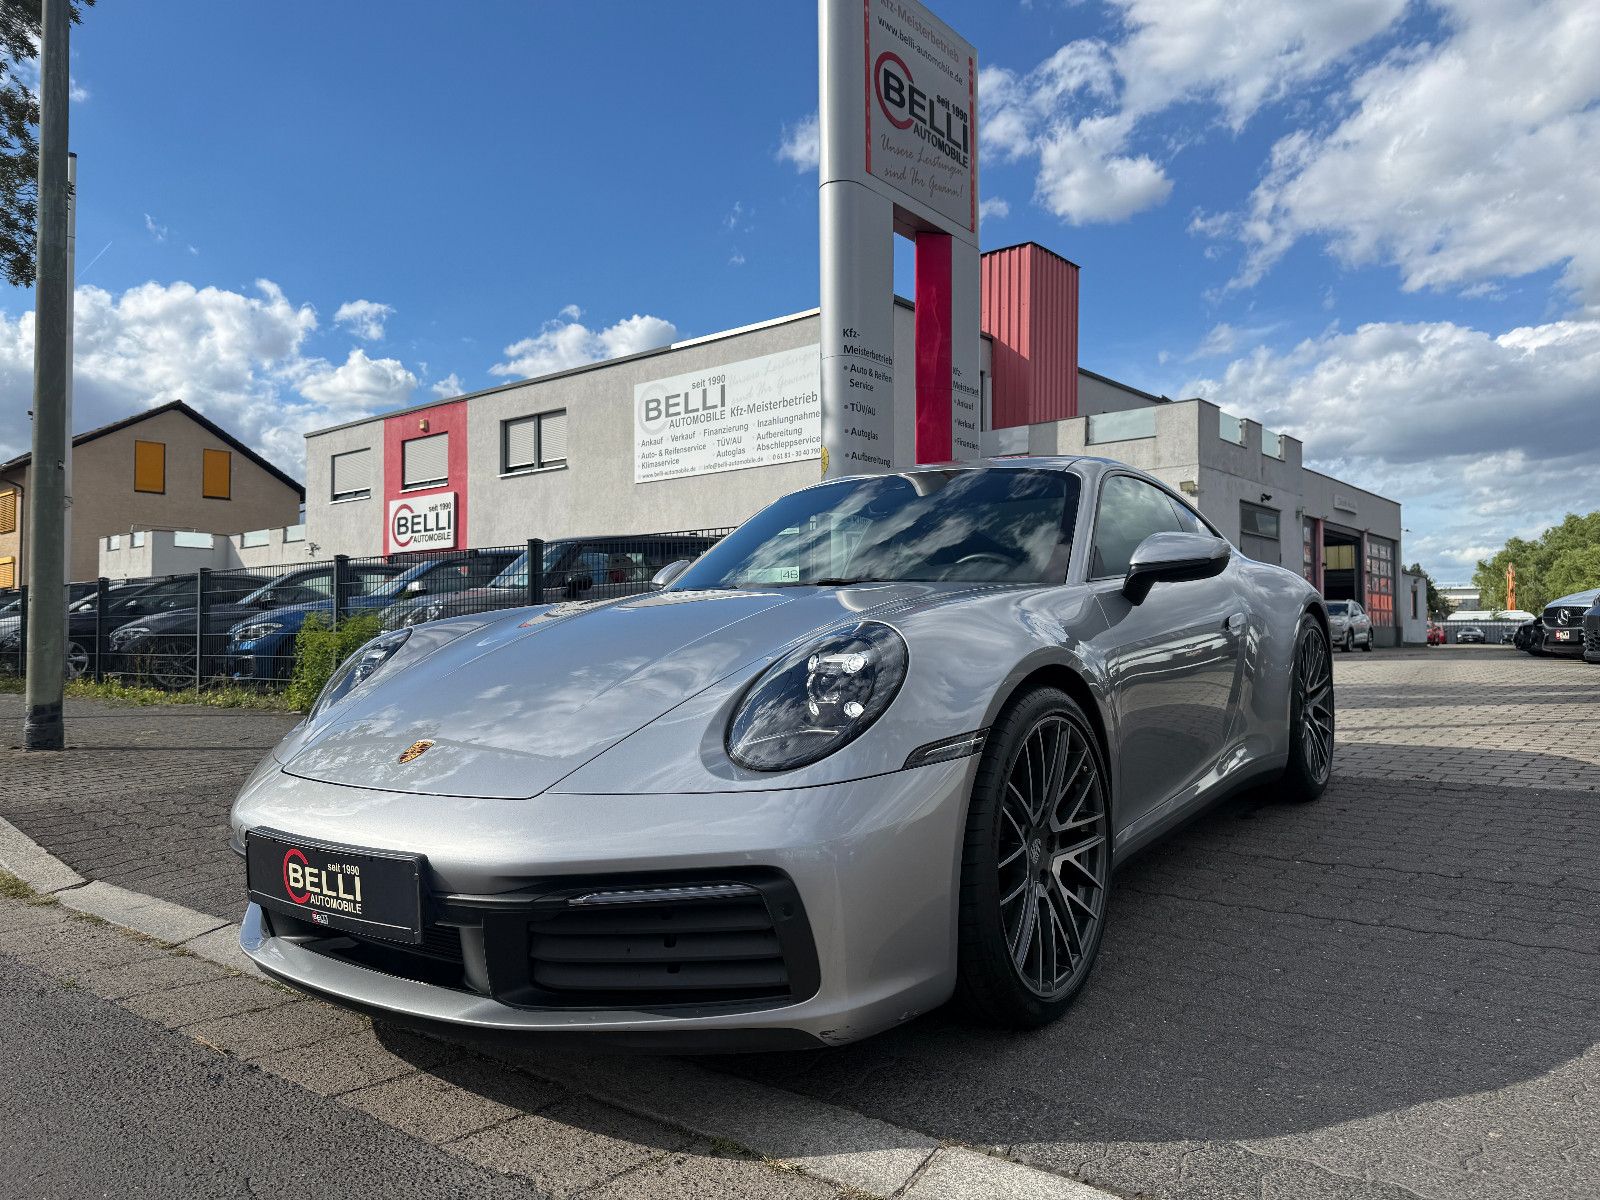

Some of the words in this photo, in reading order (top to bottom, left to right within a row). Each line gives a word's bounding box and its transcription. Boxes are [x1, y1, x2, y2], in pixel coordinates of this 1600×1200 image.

[878, 16, 963, 86] www.belli-automobile.de
[884, 67, 968, 154] BELLI
[937, 94, 949, 110] seit
[952, 103, 968, 123] 1990
[881, 134, 914, 160] Unsere
[913, 122, 968, 169] AUTOMOBILE
[884, 163, 906, 181] sind
[842, 328, 860, 338] Kfz-
[843, 344, 893, 366] Meisterbetrieb
[691, 379, 706, 389] seit
[708, 374, 726, 386] 1990
[850, 363, 868, 375] Auto
[869, 368, 873, 378] &
[874, 370, 892, 383] Reifen
[850, 379, 874, 392] Service
[645, 384, 726, 422] BELLI
[730, 391, 818, 417] Kfz-Meisterbetrieb
[850, 401, 876, 416] TÜV/AU
[669, 409, 726, 429] AUTOMOBILE
[957, 418, 975, 430] Verkauf
[641, 437, 663, 447] Ankauf
[670, 431, 696, 442] Verkauf
[703, 423, 749, 437] Finanzierung
[757, 411, 820, 428] Inzahlungnahme
[757, 427, 803, 441] Aufbereitung
[851, 427, 878, 441] Autoglas
[716, 436, 742, 447] TÜV/AU
[757, 435, 820, 451] Abschleppservice
[641, 451, 657, 459] Auto-
[658, 449, 663, 457] &
[664, 443, 707, 456] Reifenservice
[716, 447, 746, 458] Autoglas
[851, 451, 891, 468] Aufbereitung
[641, 458, 680, 469] Klimaservice
[428, 504, 438, 512] seit
[439, 502, 451, 511] 1990
[397, 510, 451, 535] BELLI
[413, 532, 451, 543] AUTOMOBILE
[327, 863, 341, 873] seit
[342, 864, 360, 876] 1990
[288, 862, 362, 901] BELLI
[310, 893, 362, 914] AUTOMOBILE
